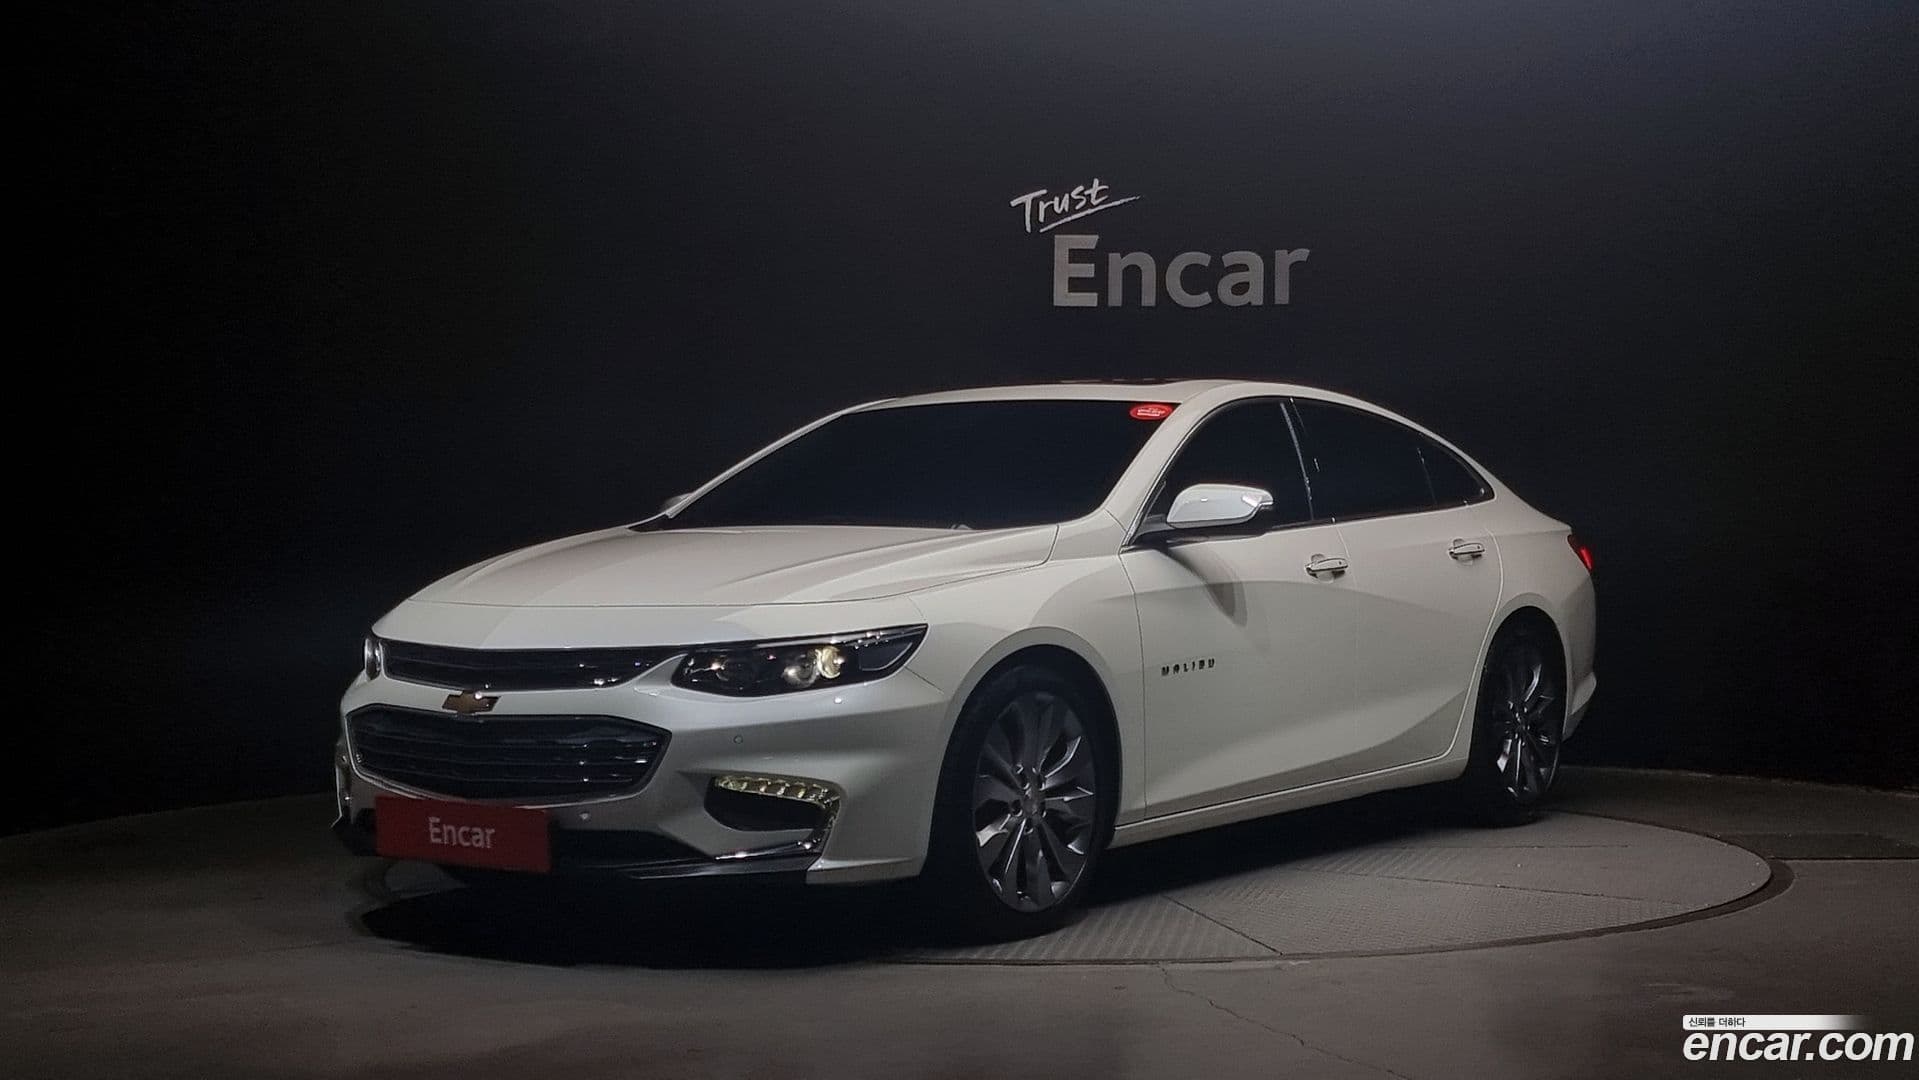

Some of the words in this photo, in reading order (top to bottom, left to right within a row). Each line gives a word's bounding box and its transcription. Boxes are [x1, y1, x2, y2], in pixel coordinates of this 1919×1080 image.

[1010, 178, 1109, 233] Trust
[1053, 234, 1310, 308] Encar
[428, 816, 496, 849] Encar
